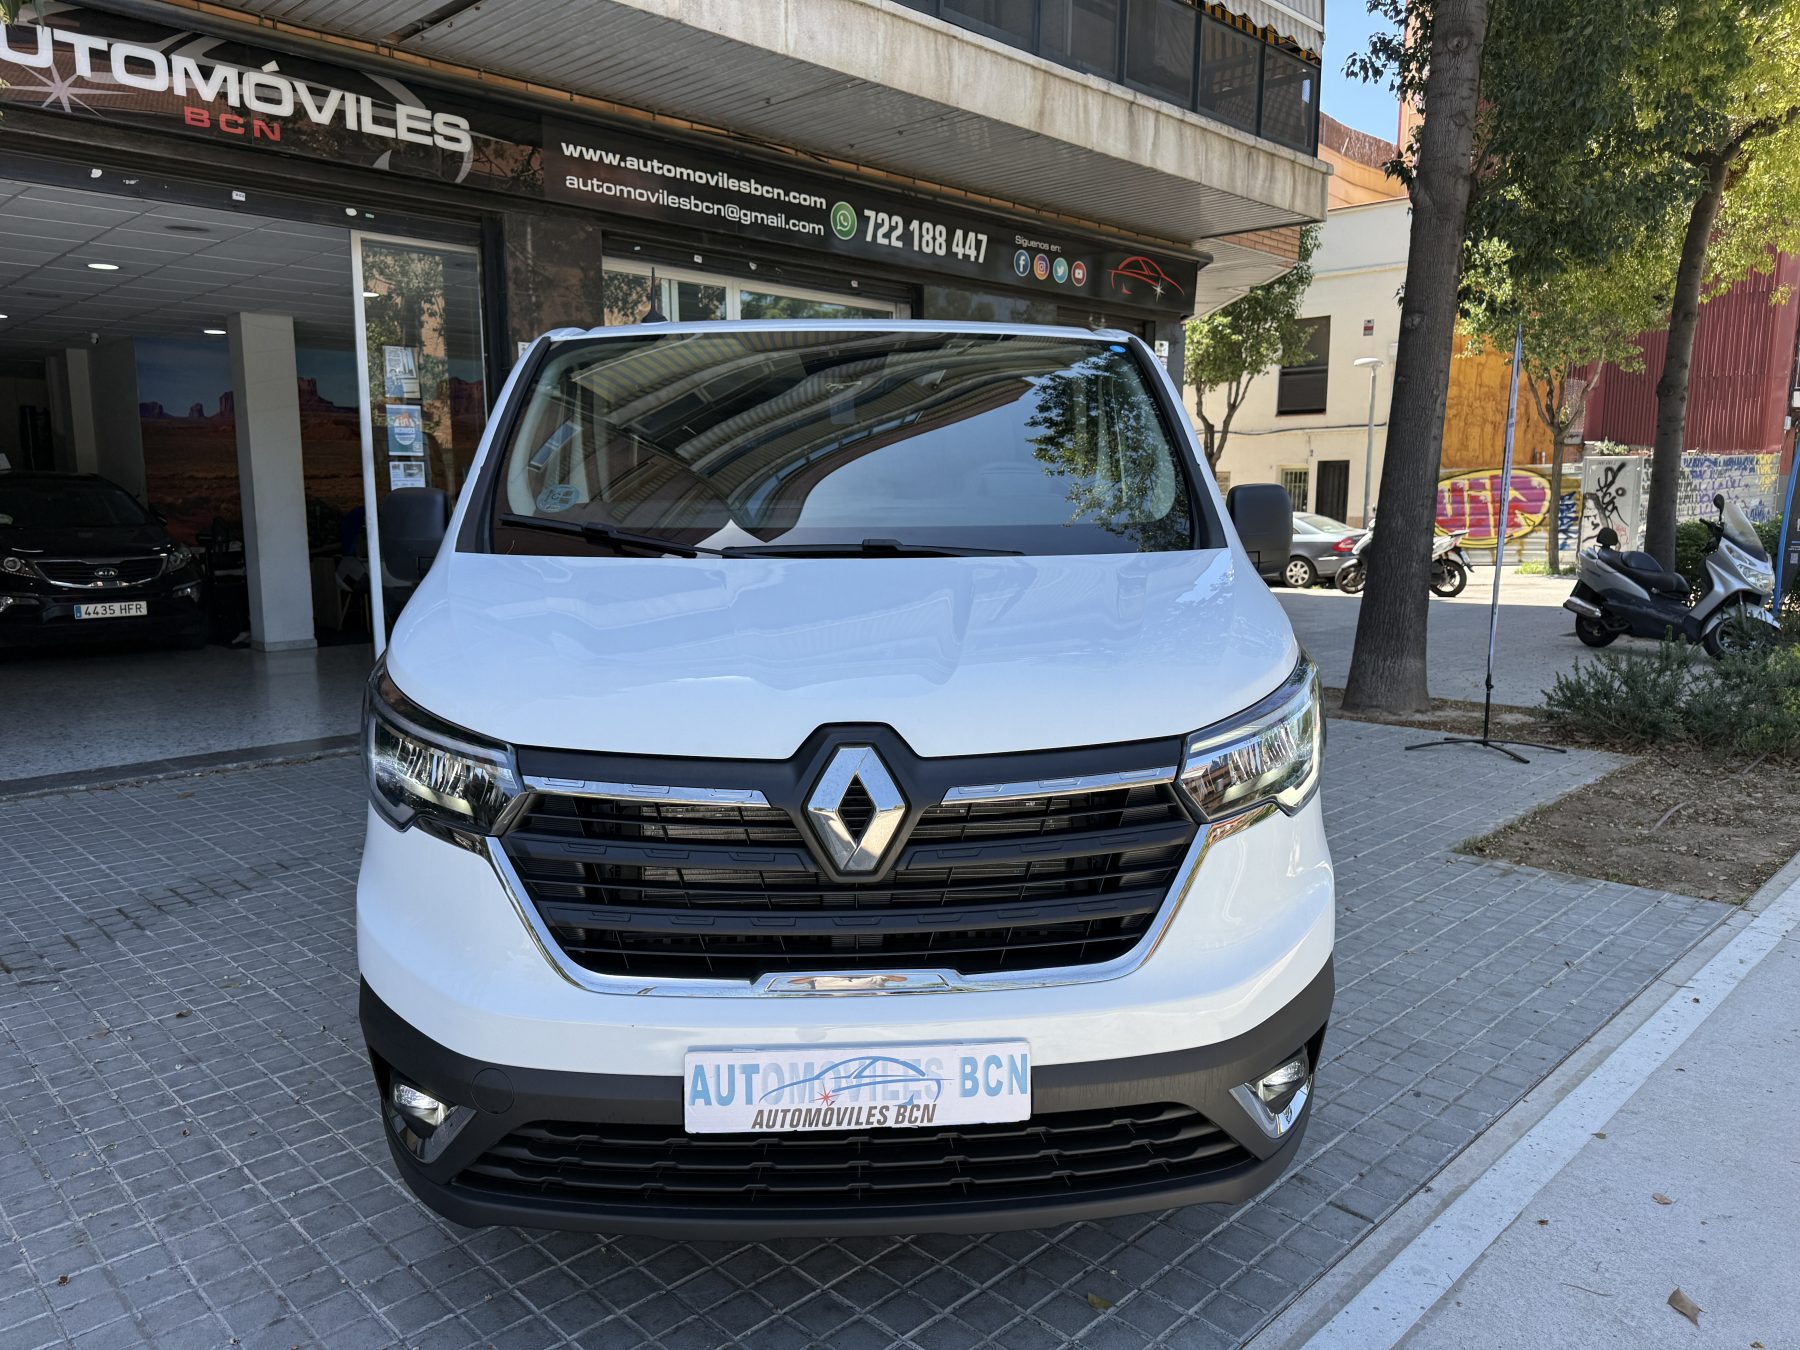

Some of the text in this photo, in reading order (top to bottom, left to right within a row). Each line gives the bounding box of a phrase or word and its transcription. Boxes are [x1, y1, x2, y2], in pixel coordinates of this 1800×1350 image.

[184, 106, 281, 142] BCN
[561, 141, 826, 210] www.automovilesbcn.com
[565, 174, 825, 236] automovilesbcn@gmail.com
[863, 209, 988, 264] 722 188 447
[84, 603, 143, 616] 4435 HFR
[959, 1054, 1029, 1098] BCN
[751, 1100, 937, 1129] AUTOMÓVILES BCN
